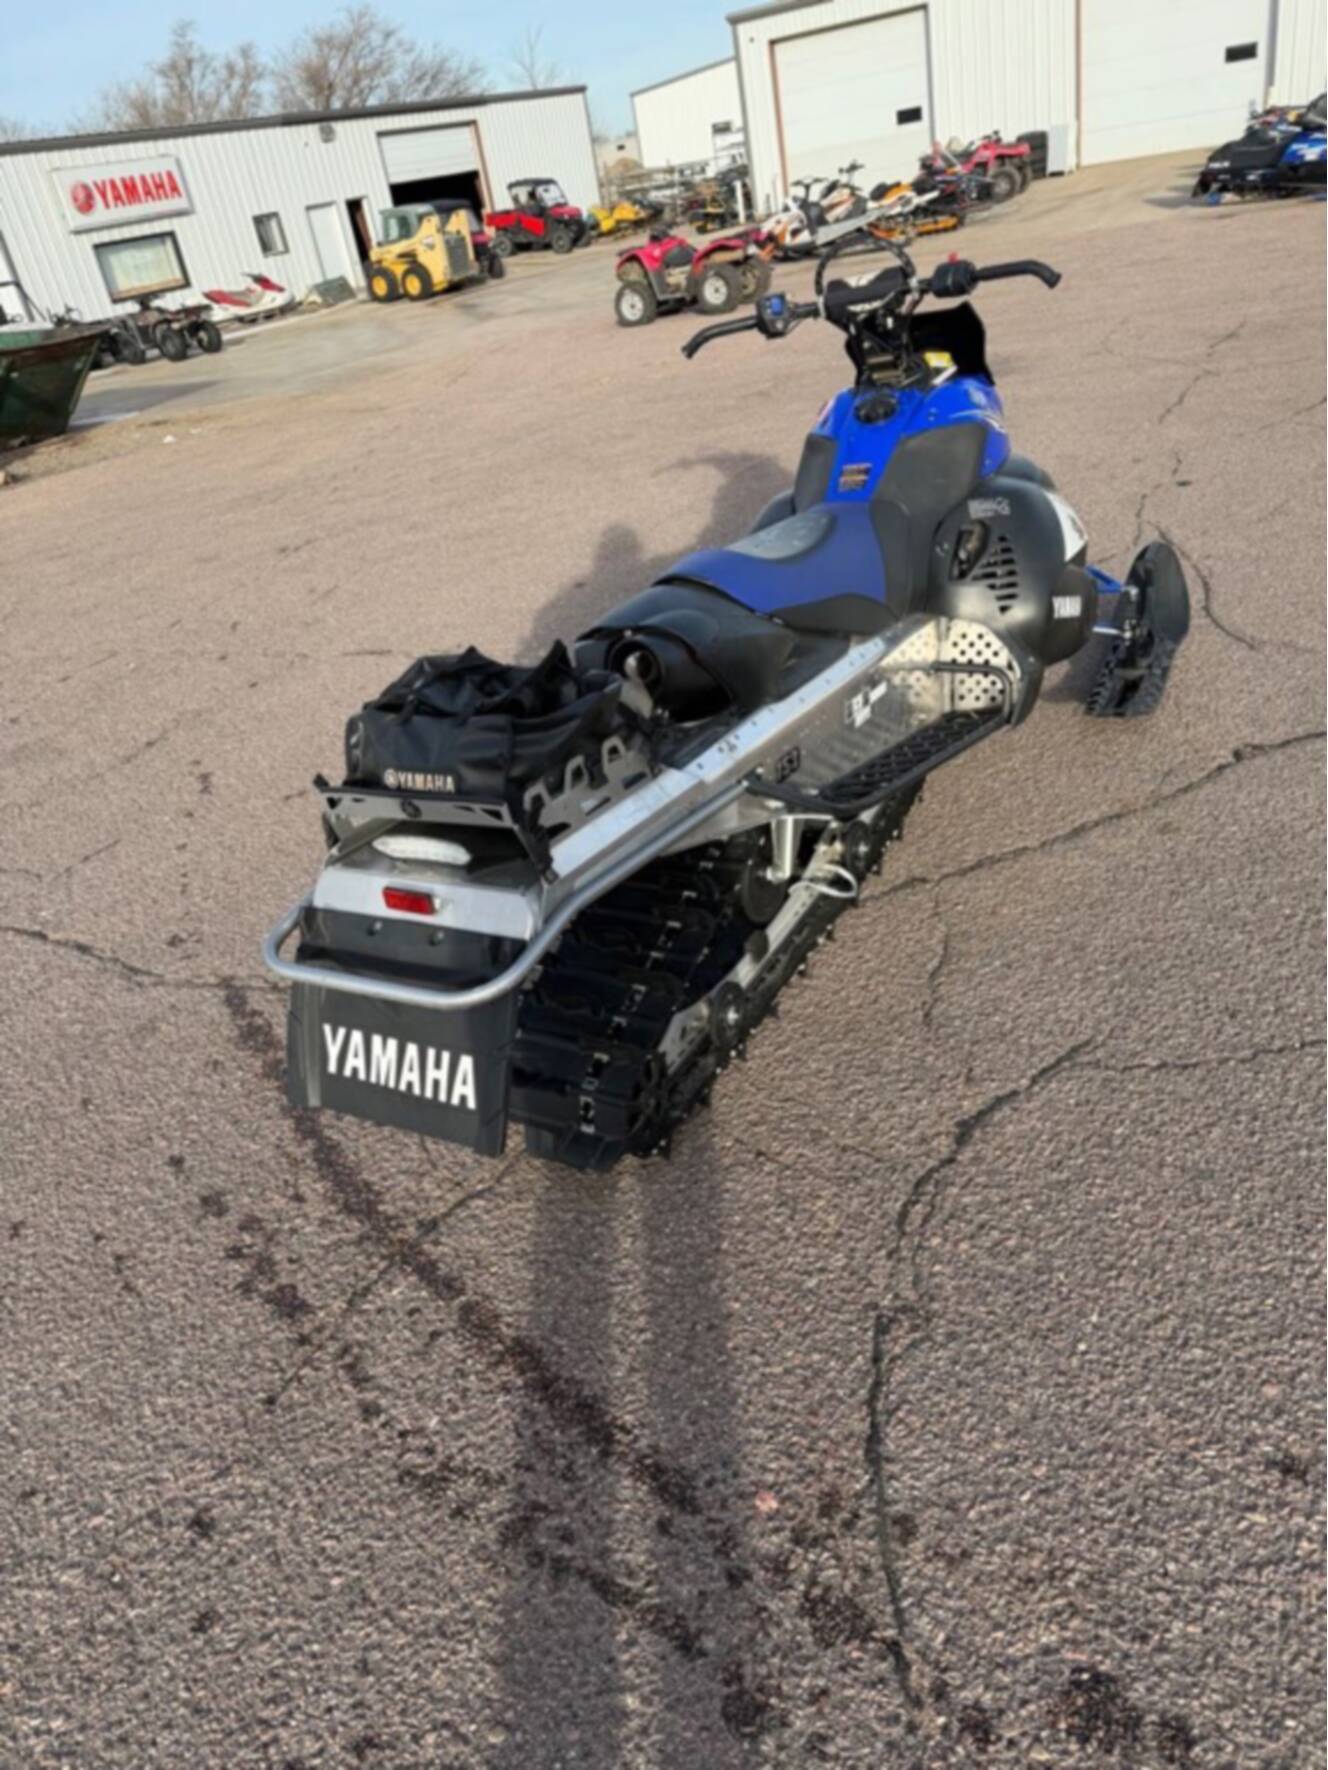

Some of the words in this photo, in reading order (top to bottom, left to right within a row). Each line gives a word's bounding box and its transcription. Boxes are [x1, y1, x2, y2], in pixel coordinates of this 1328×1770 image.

[93, 169, 183, 209] YAMAHA
[398, 771, 455, 793] YAMAHA
[322, 1022, 477, 1111] YAMAHA
